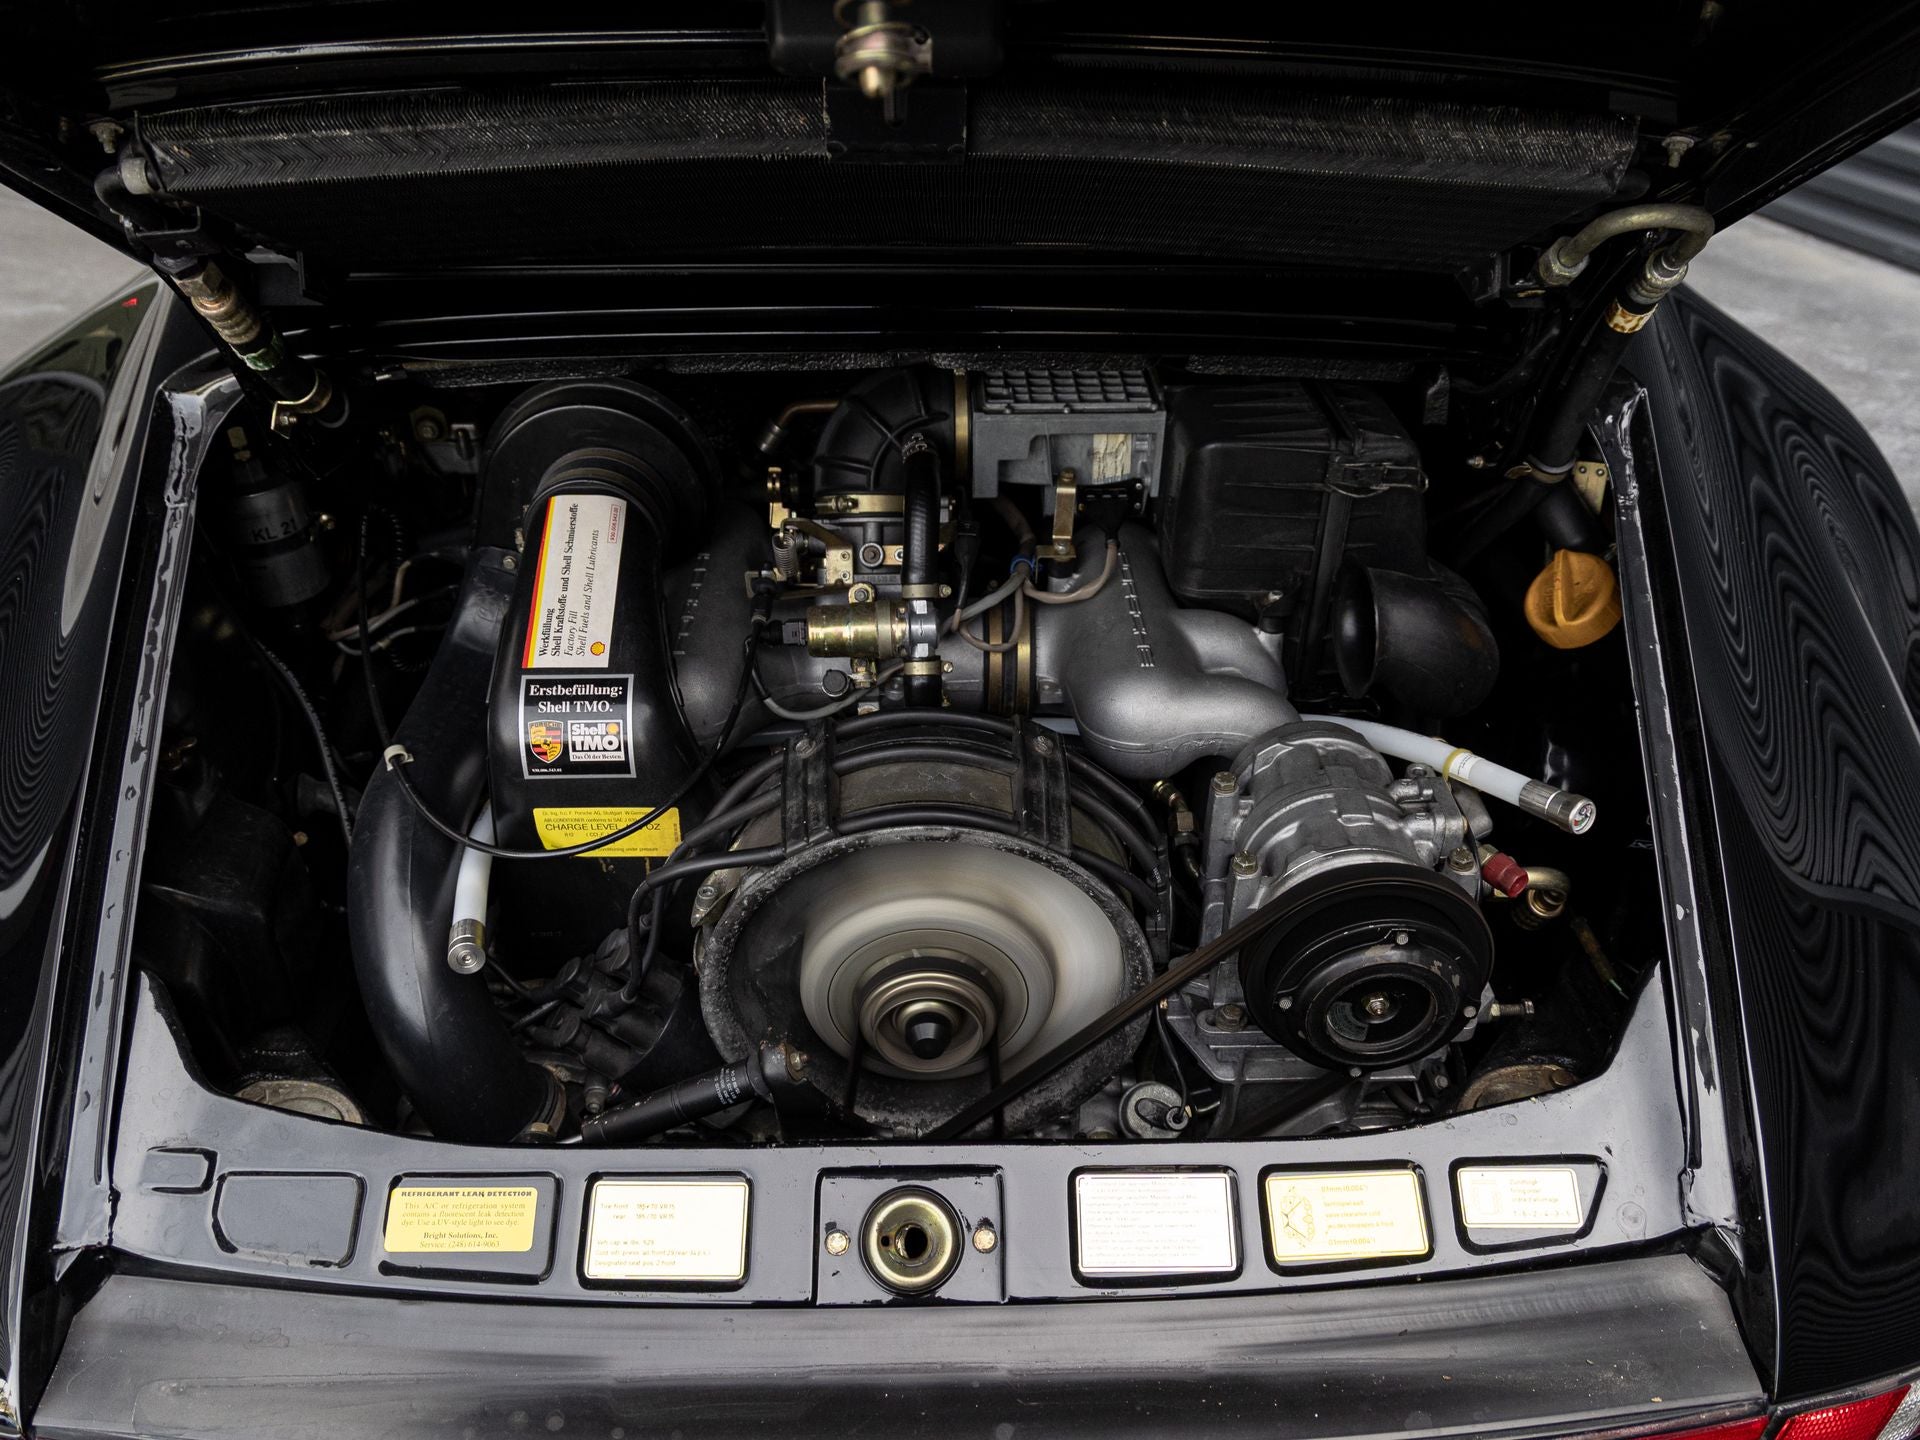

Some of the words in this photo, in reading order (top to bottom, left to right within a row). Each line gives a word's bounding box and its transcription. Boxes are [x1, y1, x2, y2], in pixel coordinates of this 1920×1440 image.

[564, 503, 578, 554] Schmierstoffe
[590, 530, 600, 570] Lubricants
[562, 556, 572, 576] Shell
[561, 577, 570, 592] und
[584, 572, 594, 592] Shell
[583, 596, 592, 610] and
[554, 593, 568, 634] Kraftstoffe
[568, 610, 578, 624] Fill
[580, 612, 590, 634] Fuels
[538, 608, 555, 656] Werkfüllung
[564, 624, 578, 656] Factory
[551, 634, 562, 656] Shell
[576, 634, 586, 656] Shell
[529, 684, 623, 696] Erstbefüllung:
[538, 700, 570, 713] Shell
[574, 700, 614, 712] TMO.
[572, 724, 606, 736] Shell
[572, 736, 618, 750] TMO
